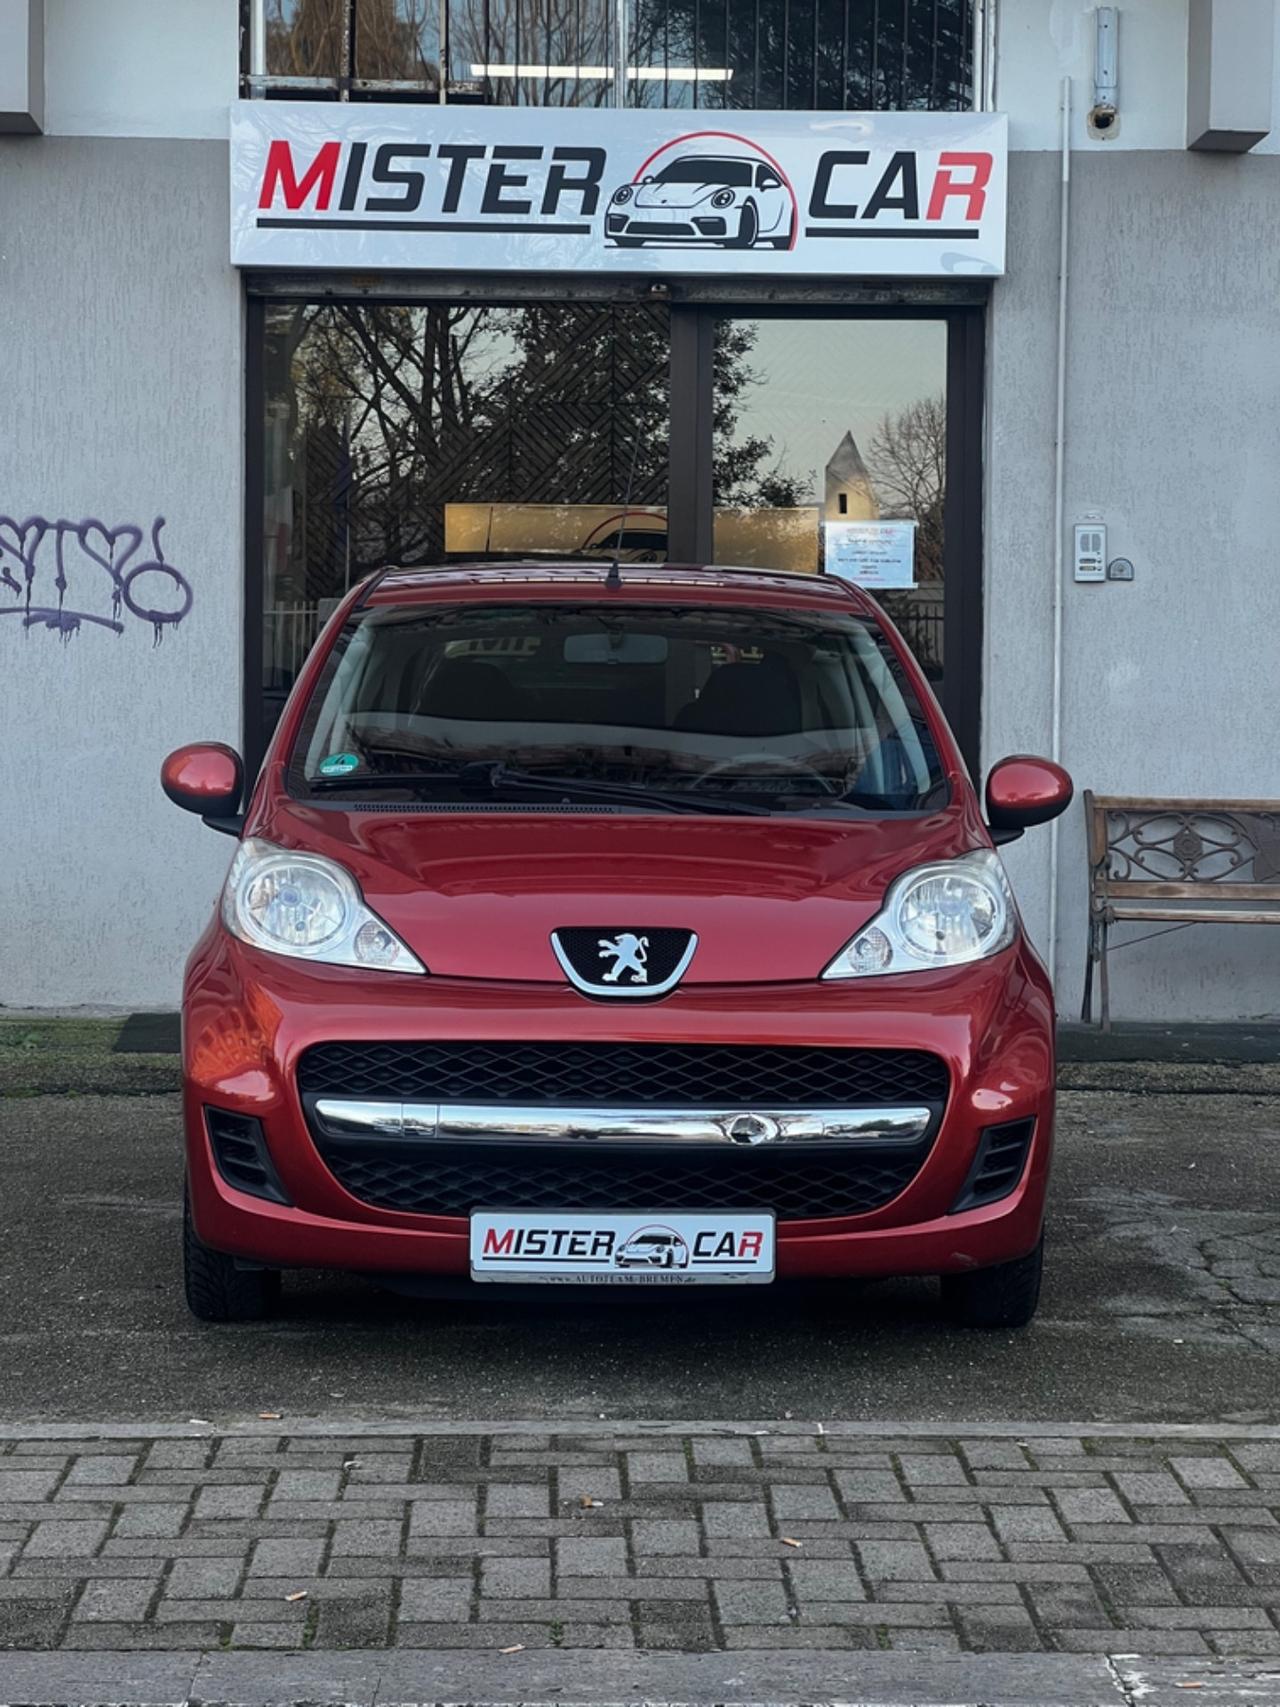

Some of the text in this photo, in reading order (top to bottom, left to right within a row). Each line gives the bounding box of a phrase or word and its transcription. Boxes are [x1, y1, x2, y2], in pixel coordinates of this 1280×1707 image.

[259, 140, 994, 221] MISTER CAR
[482, 1228, 763, 1257] MISTER CAR
